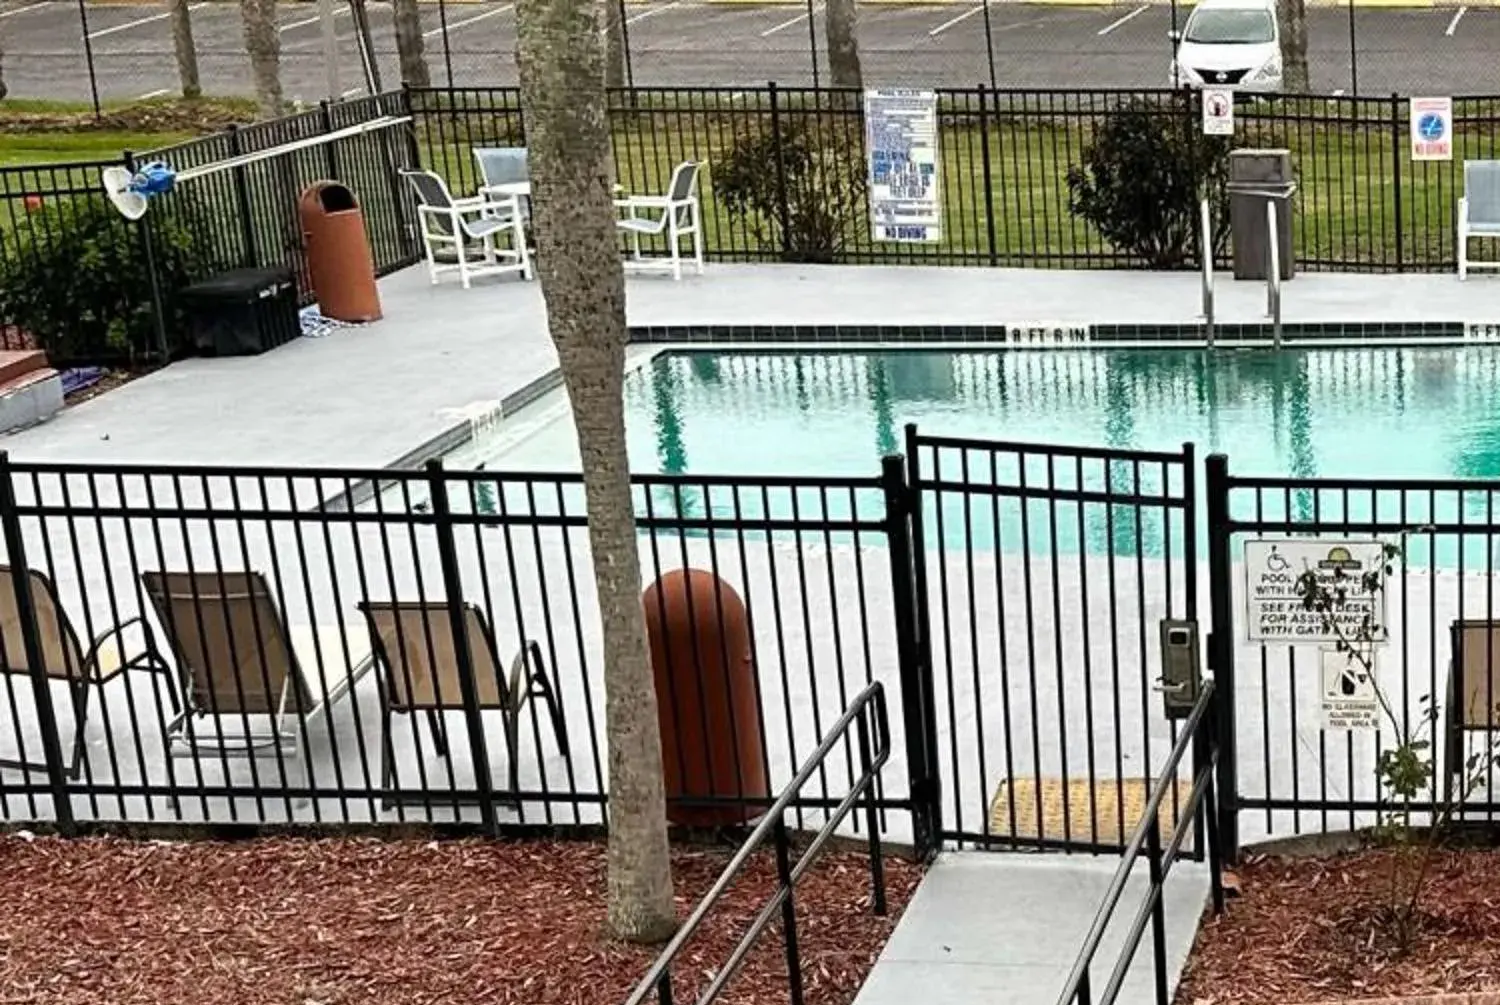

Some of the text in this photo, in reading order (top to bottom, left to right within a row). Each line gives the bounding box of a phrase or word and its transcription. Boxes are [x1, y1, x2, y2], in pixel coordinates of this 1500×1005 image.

[1414, 142, 1425, 155] NO
[885, 227, 927, 239] NO DIVING
[1028, 327, 1046, 342] FT
[1069, 327, 1085, 342] IN
[1256, 585, 1285, 595] WITH
[1261, 603, 1284, 612] SEE
[1335, 603, 1370, 613] DESK
[1261, 613, 1287, 623] FOR
[1260, 625, 1292, 635] WITH
[1295, 625, 1329, 635] GAT
